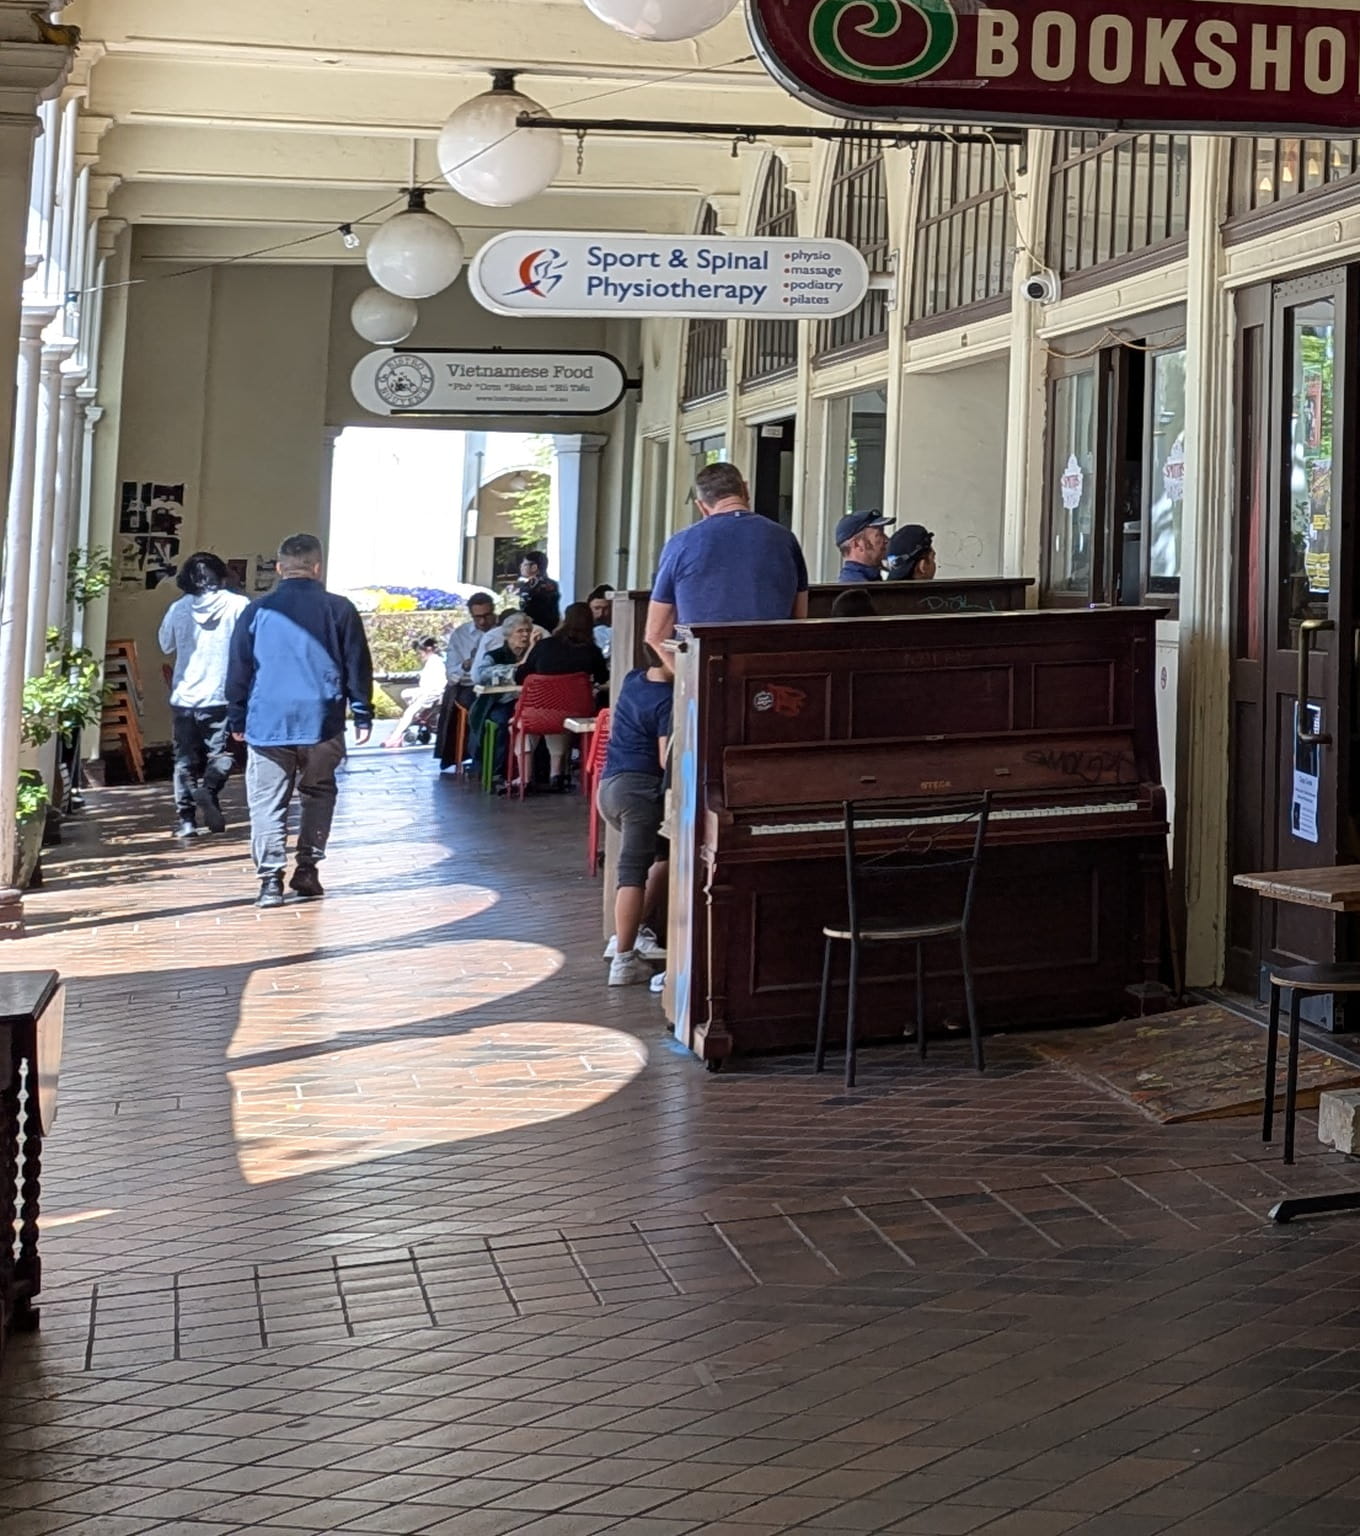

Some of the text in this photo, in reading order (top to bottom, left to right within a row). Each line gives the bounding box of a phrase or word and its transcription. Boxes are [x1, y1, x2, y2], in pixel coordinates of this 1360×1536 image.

[586, 246, 769, 275] Sport & Spinal
[790, 249, 831, 263] physio
[790, 265, 843, 278] massage
[586, 275, 768, 305] Physiotherapy
[790, 280, 844, 294] podiatry
[789, 295, 830, 307] pilates
[446, 364, 595, 380] Vietnamese Food
